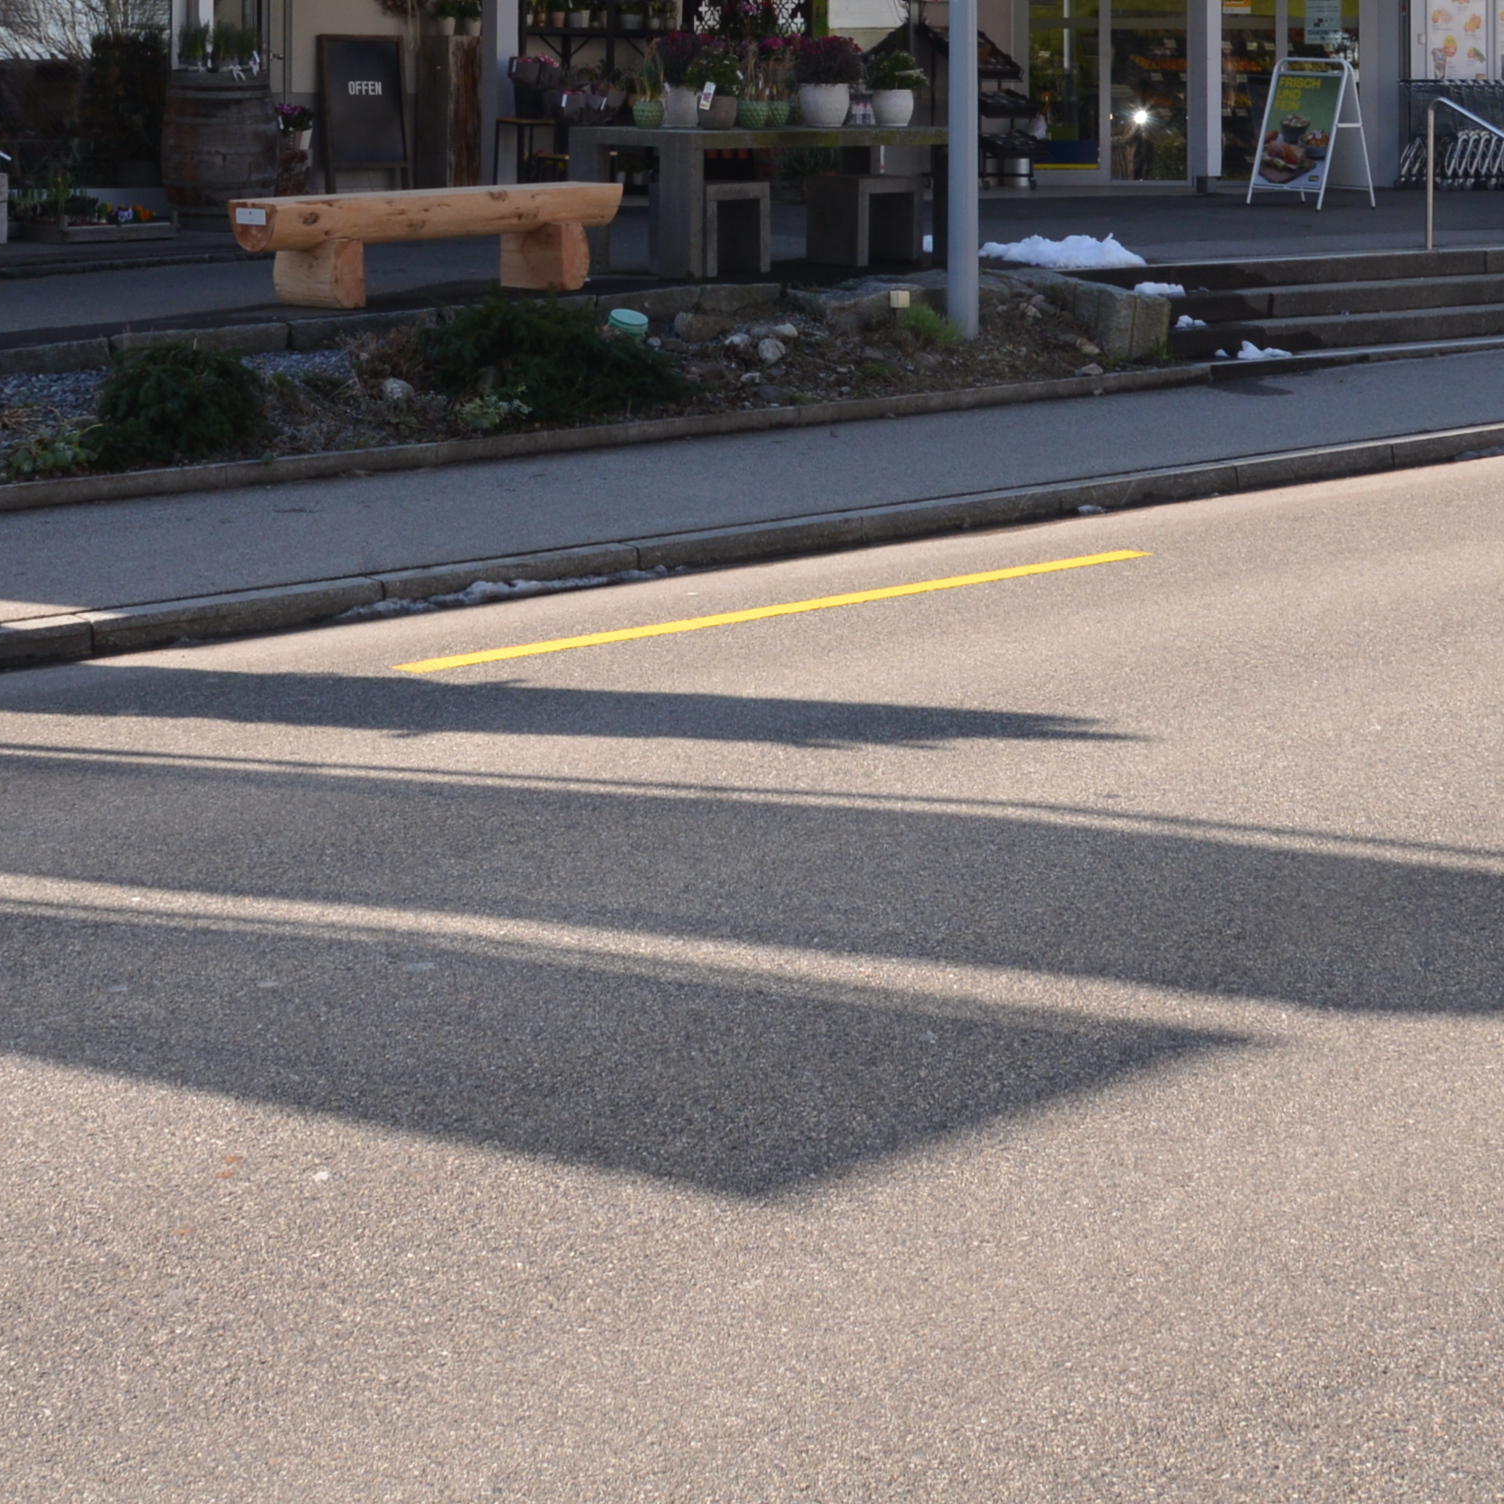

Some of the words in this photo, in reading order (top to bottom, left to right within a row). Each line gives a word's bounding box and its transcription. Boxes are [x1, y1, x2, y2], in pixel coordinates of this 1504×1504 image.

[348, 81, 382, 96] OFFEN
[1279, 77, 1322, 89] FRISCH
[1277, 89, 1303, 100] UND
[1274, 100, 1301, 111] FEIN
